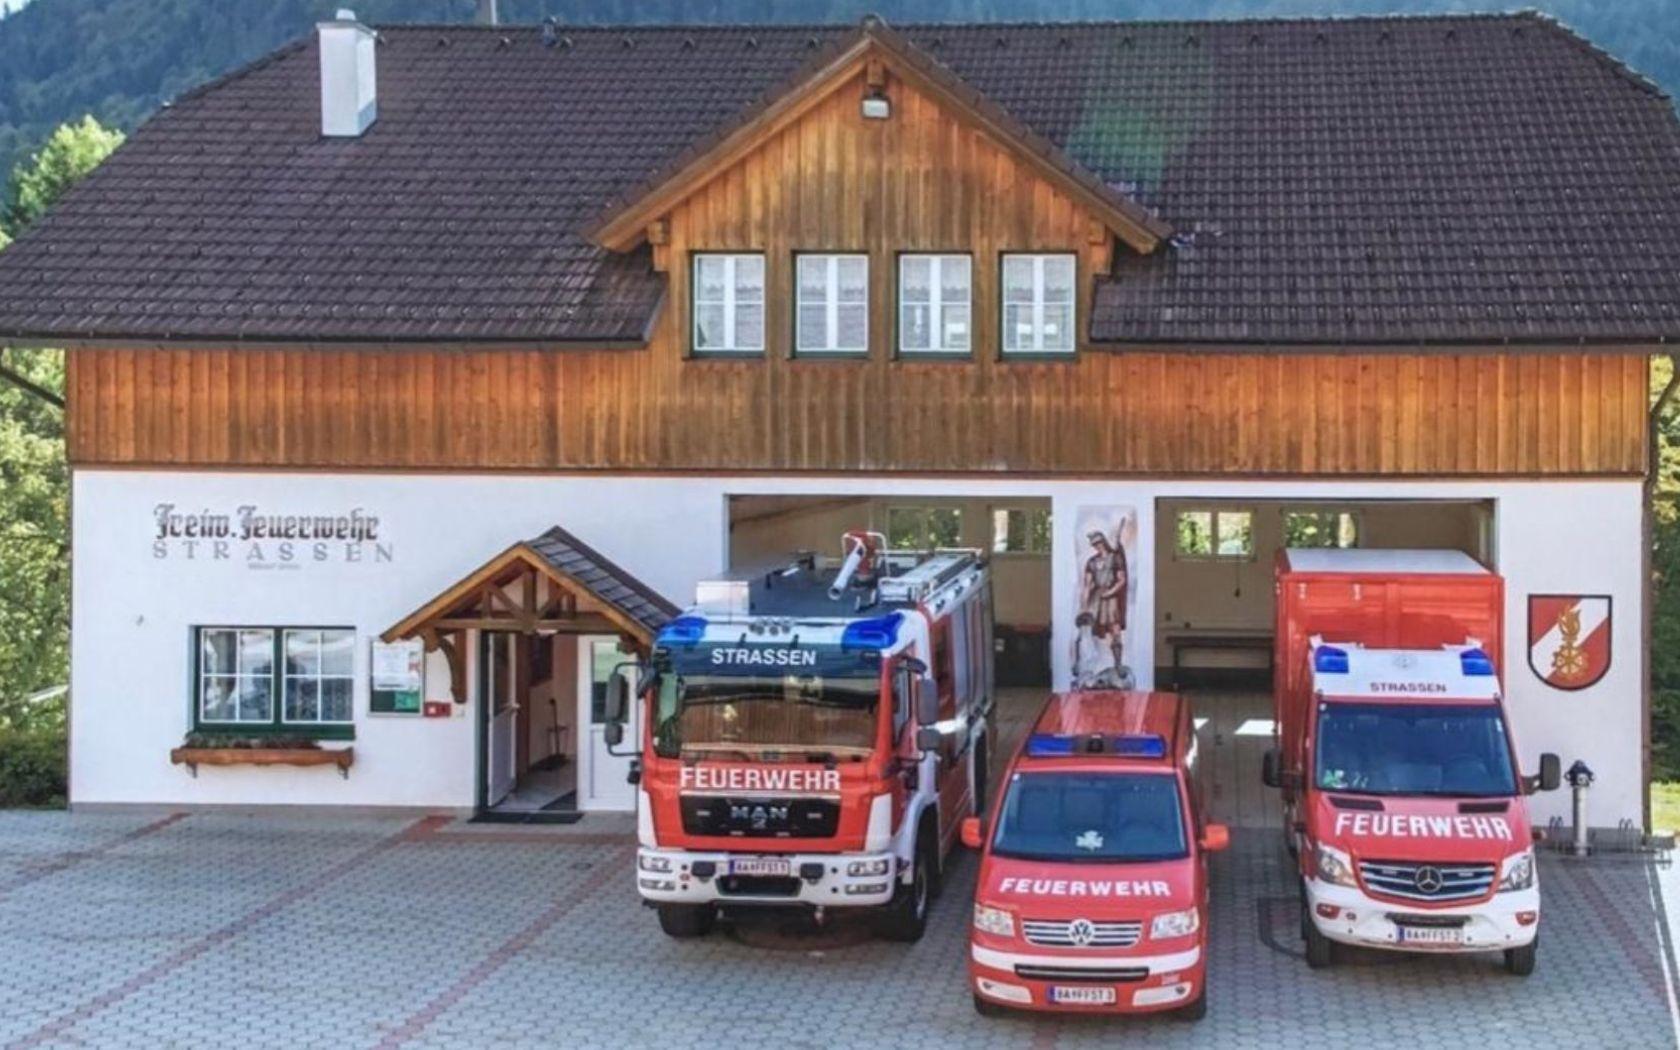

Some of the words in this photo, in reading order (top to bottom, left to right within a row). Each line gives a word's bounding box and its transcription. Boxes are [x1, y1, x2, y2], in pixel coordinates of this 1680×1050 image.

[237, 505, 379, 542] Feuerwehr
[153, 540, 393, 562] STRASSEN
[711, 647, 816, 666] STRASSEN
[1370, 681, 1447, 694] STRASSEN
[680, 767, 840, 790] FEUERWEHR
[731, 806, 787, 819] MAN
[1335, 813, 1512, 840] FEUERWEHR
[1000, 877, 1171, 896] FEUERWEHR
